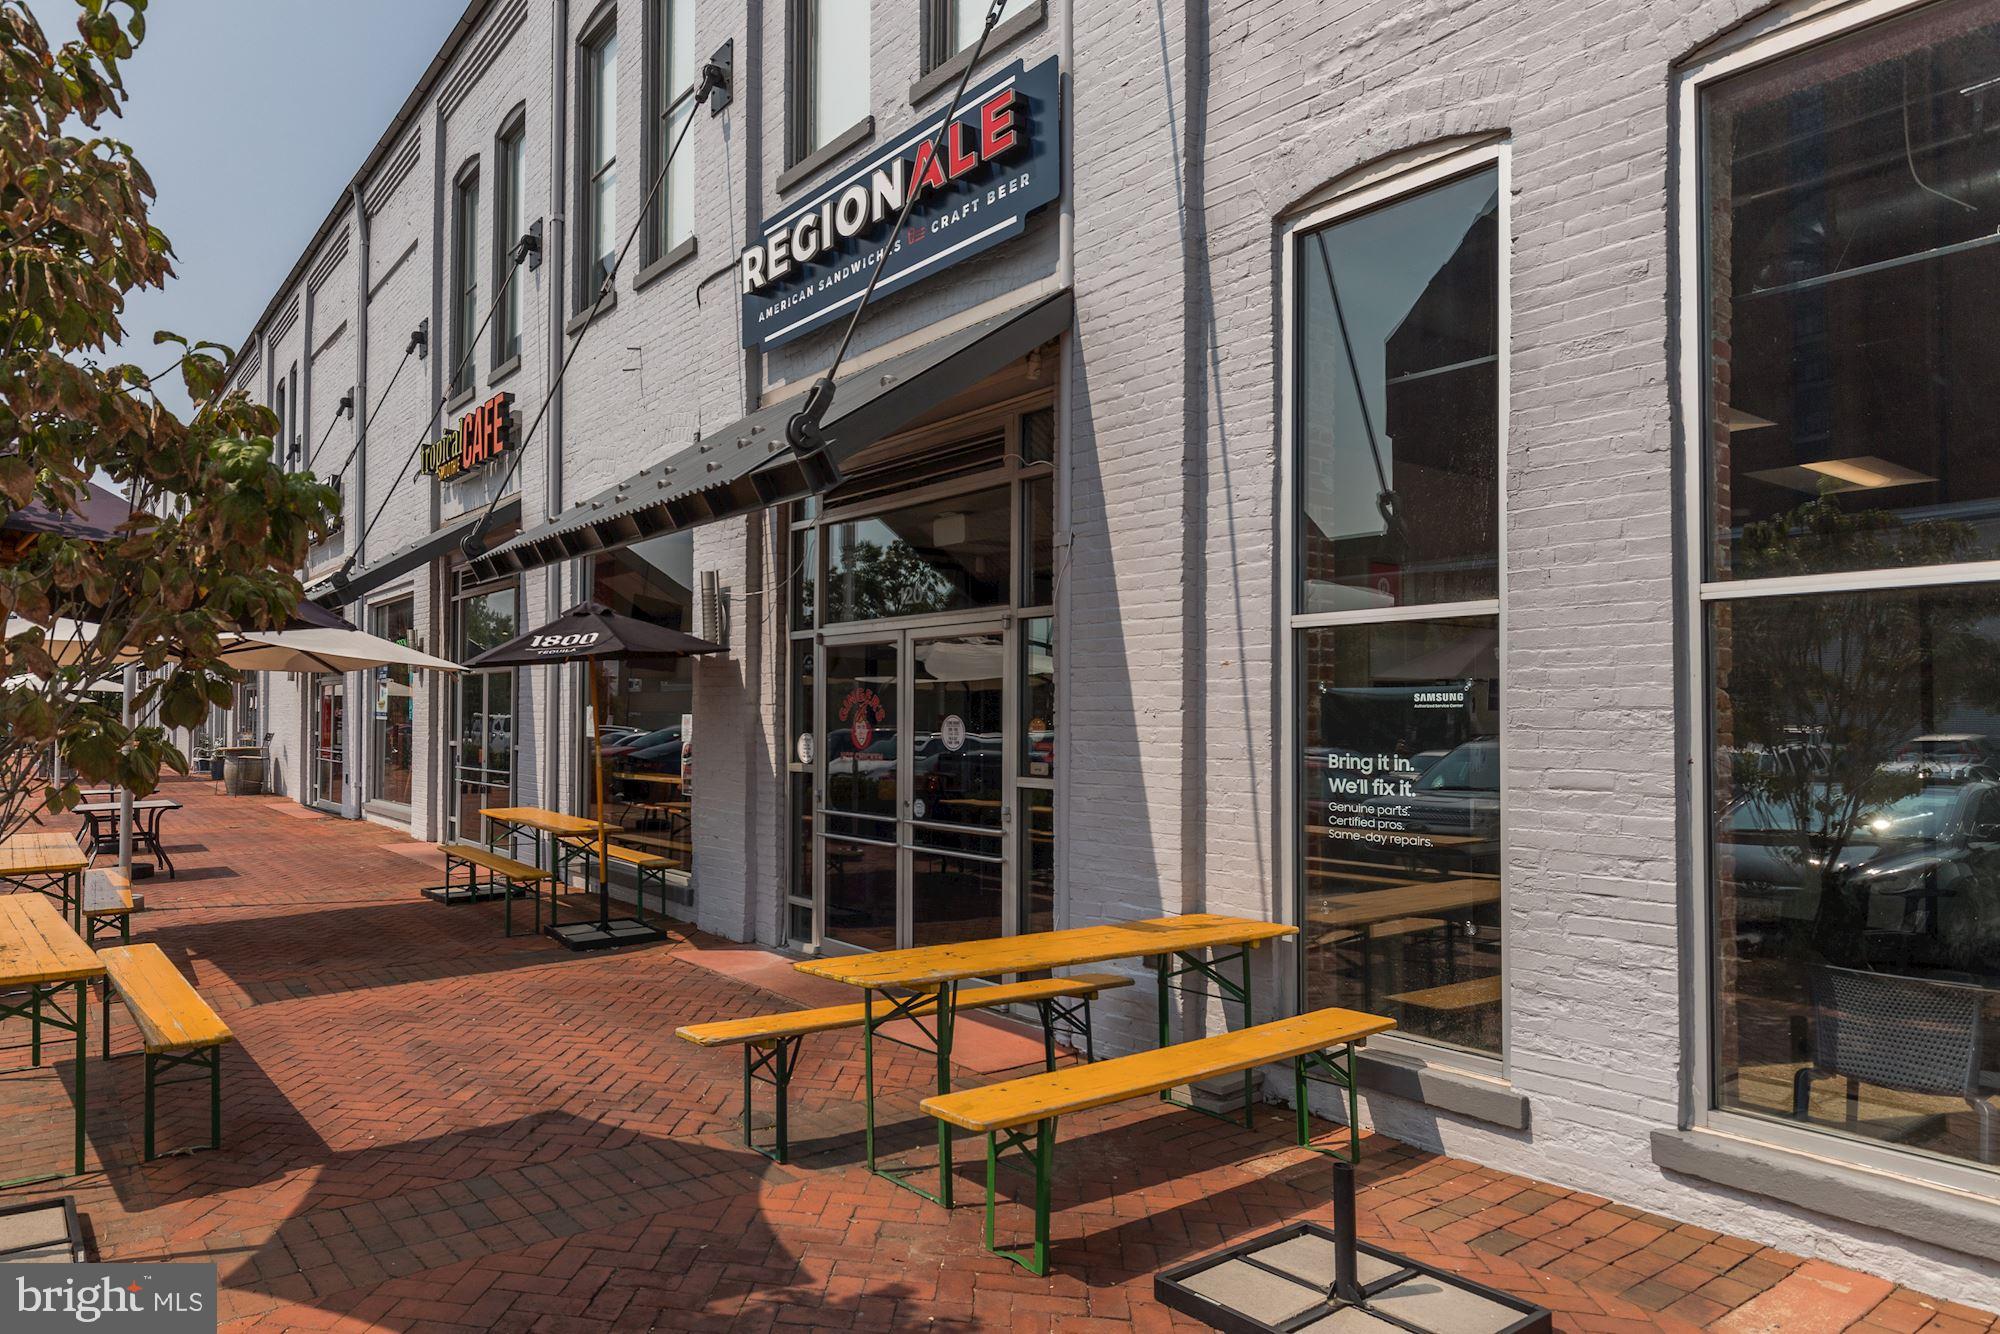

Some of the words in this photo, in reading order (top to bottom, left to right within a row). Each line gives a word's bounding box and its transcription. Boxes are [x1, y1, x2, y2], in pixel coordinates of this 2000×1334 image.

[742, 88, 1017, 293] REGIONALE
[758, 285, 814, 322] AMERICAN
[818, 240, 902, 291] SANDWICHS
[931, 198, 979, 233] CRAFT
[987, 173, 1031, 205] BEER
[420, 417, 463, 474] tropical
[462, 392, 507, 470] CAFE
[530, 632, 599, 648] 1800
[1413, 693, 1464, 702] SAMSUNG
[1328, 753, 1373, 775] Bring
[1378, 754, 1390, 771] it
[1394, 754, 1415, 771] in.
[1328, 777, 1368, 794] We'll
[1372, 779, 1395, 796] fix
[1400, 780, 1417, 798] it.
[1328, 802, 1375, 814] Genuine
[1377, 804, 1411, 817] parts.
[1328, 816, 1375, 828] Certified
[1378, 820, 1405, 831] pros.
[1328, 829, 1388, 846] Same-day
[1389, 834, 1434, 848] repairs.
